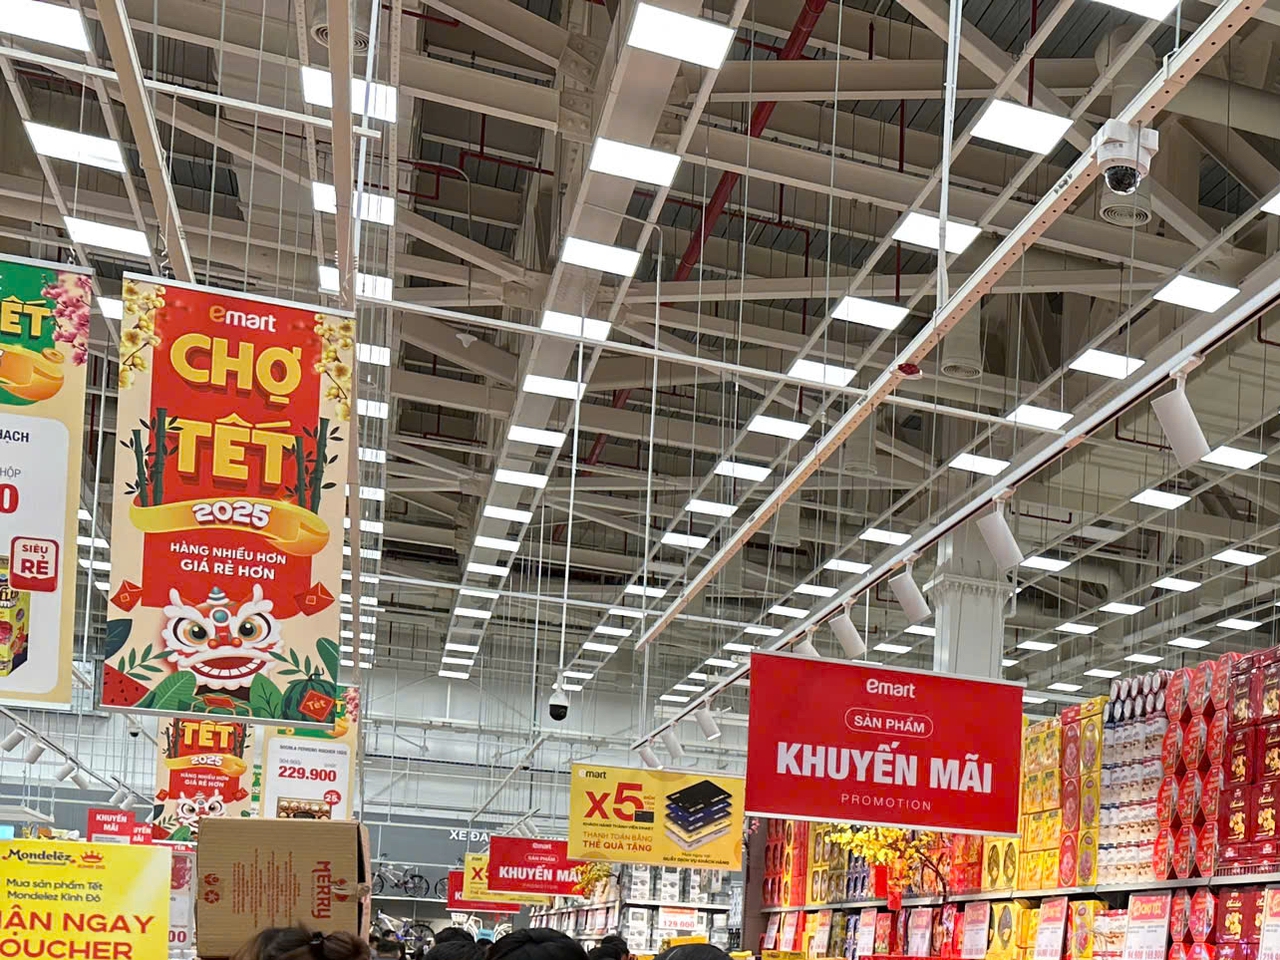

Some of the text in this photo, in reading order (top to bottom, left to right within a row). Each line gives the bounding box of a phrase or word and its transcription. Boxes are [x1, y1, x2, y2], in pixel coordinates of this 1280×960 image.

[0, 295, 49, 336] ẾT
[209, 303, 276, 334] emart
[169, 333, 302, 404] CHỢ
[165, 413, 298, 487] TẾT
[192, 500, 274, 528] 2025
[22, 543, 48, 555] SIÊU
[170, 542, 287, 565] HÀNG NHIỀU HƠN
[20, 554, 49, 577] RẺ
[180, 556, 276, 581] GIÁ RẺ HƠN
[866, 678, 916, 699] emart
[307, 698, 327, 711] Tết
[181, 719, 235, 748] TẾT
[854, 711, 925, 734] SẢN PHẨM
[190, 755, 223, 766] 2025
[776, 740, 993, 794] KHUYẾN MÃI
[278, 766, 337, 782] 229.900
[841, 793, 932, 811] PROMOTION
[96, 812, 127, 823] KHUYẾN
[449, 829, 467, 840] XE
[582, 839, 652, 853] THẺ QUÀ TẶNG
[499, 865, 552, 881] KHUYẾN
[6, 878, 103, 891] Mua sản phẩm Tết
[7, 890, 101, 903] Mondelez Kinh Đô
[63, 912, 155, 934] NGAY
[0, 938, 133, 960] OUCHER
